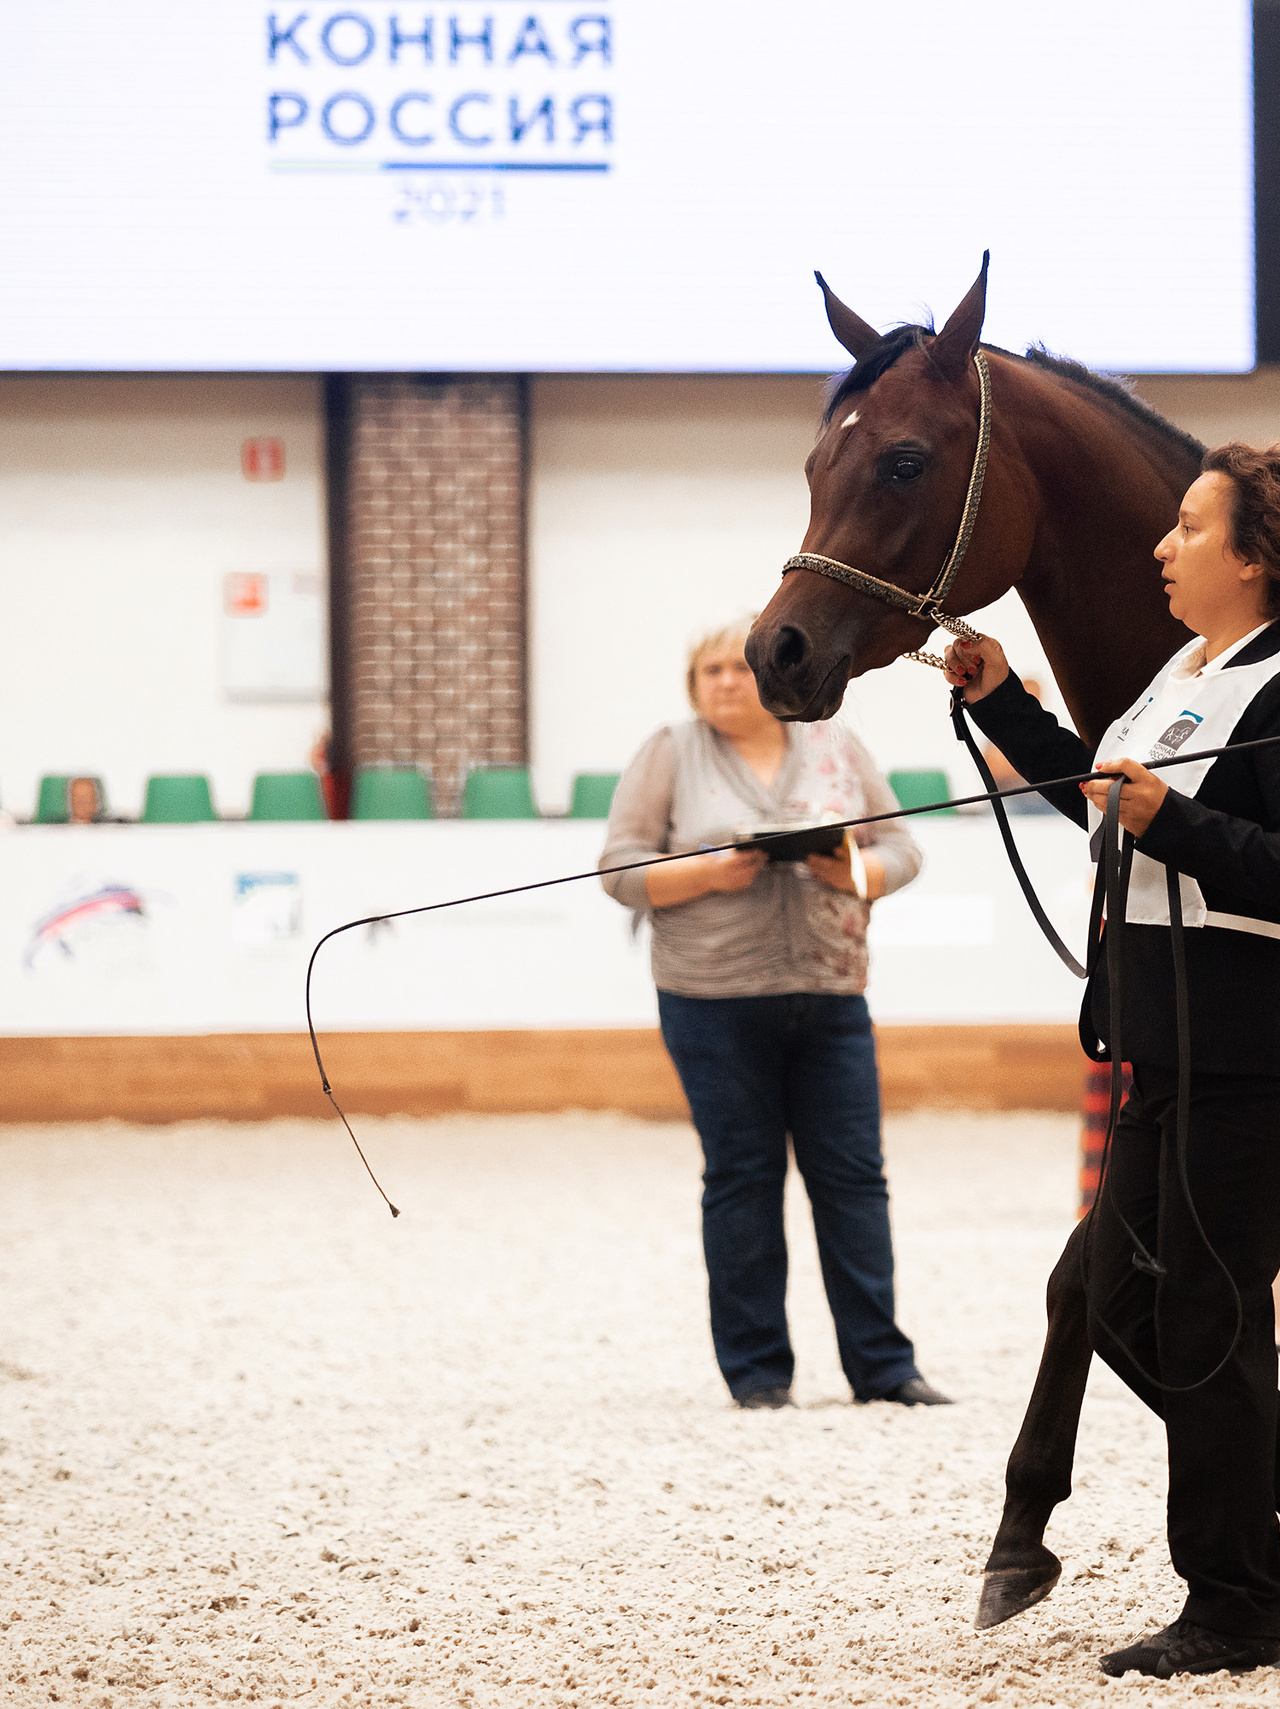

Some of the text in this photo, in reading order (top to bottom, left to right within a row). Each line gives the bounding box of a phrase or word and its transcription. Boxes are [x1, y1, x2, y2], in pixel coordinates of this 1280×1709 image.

[268, 12, 612, 66] КОННАЯ
[268, 91, 612, 146] РОССИЯ
[392, 180, 506, 225] 2021
